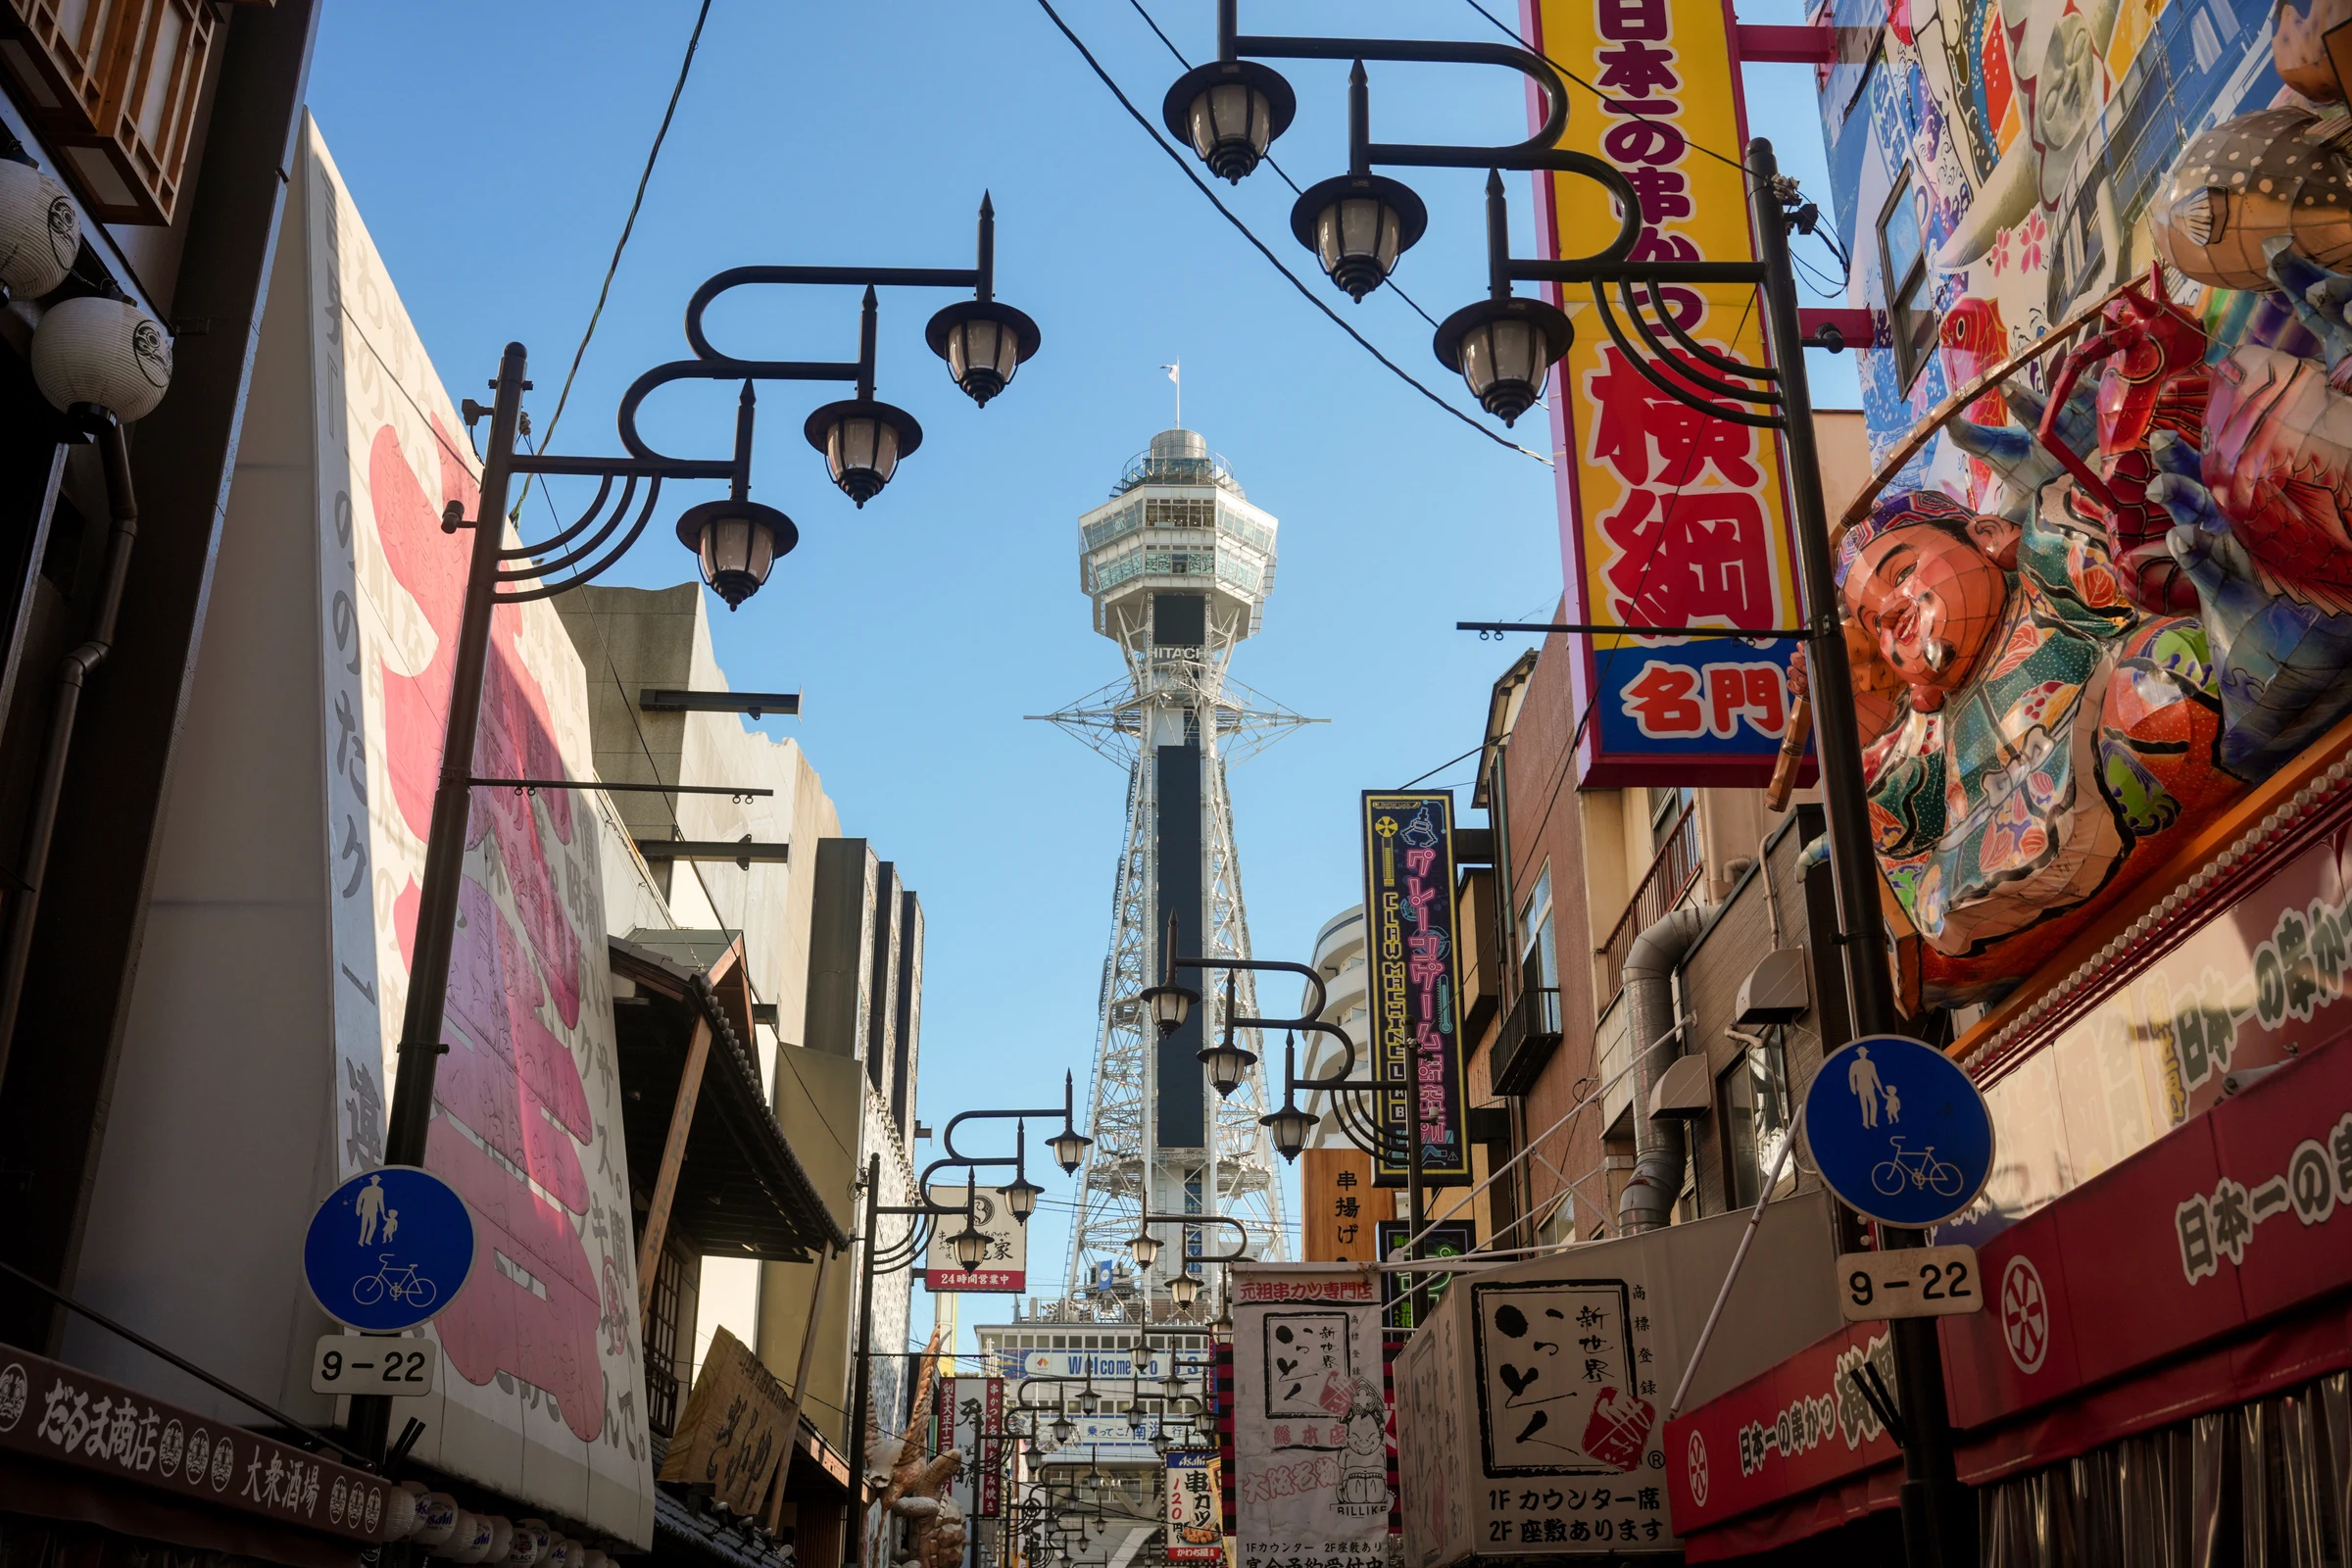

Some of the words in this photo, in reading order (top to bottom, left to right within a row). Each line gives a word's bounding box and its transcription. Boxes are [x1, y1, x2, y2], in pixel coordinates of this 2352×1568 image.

[1590, 345, 1775, 642] 横綱
[1625, 663, 1787, 737] 名門
[1383, 892, 1401, 959] CLAW
[1335, 1170, 1361, 1261] 串揚げ
[941, 1273, 1009, 1286] 24時間営業中
[1240, 1282, 1374, 1300] 元祖串カツ専門店
[1576, 1305, 1615, 1384] 新世界
[1632, 1284, 1658, 1396] 商標登録
[37, 1377, 161, 1472] だるま商店
[241, 1445, 320, 1520] 大衆酒場
[1179, 1454, 1206, 1467] Asahi
[1739, 1394, 1836, 1477] 日本一の串かつ
[1185, 1470, 1211, 1527] 串カツ
[1243, 1456, 1342, 1505] 大阪名物
[1519, 1487, 1661, 1511] カウンター席
[1520, 1518, 1663, 1544] 座敷あります
